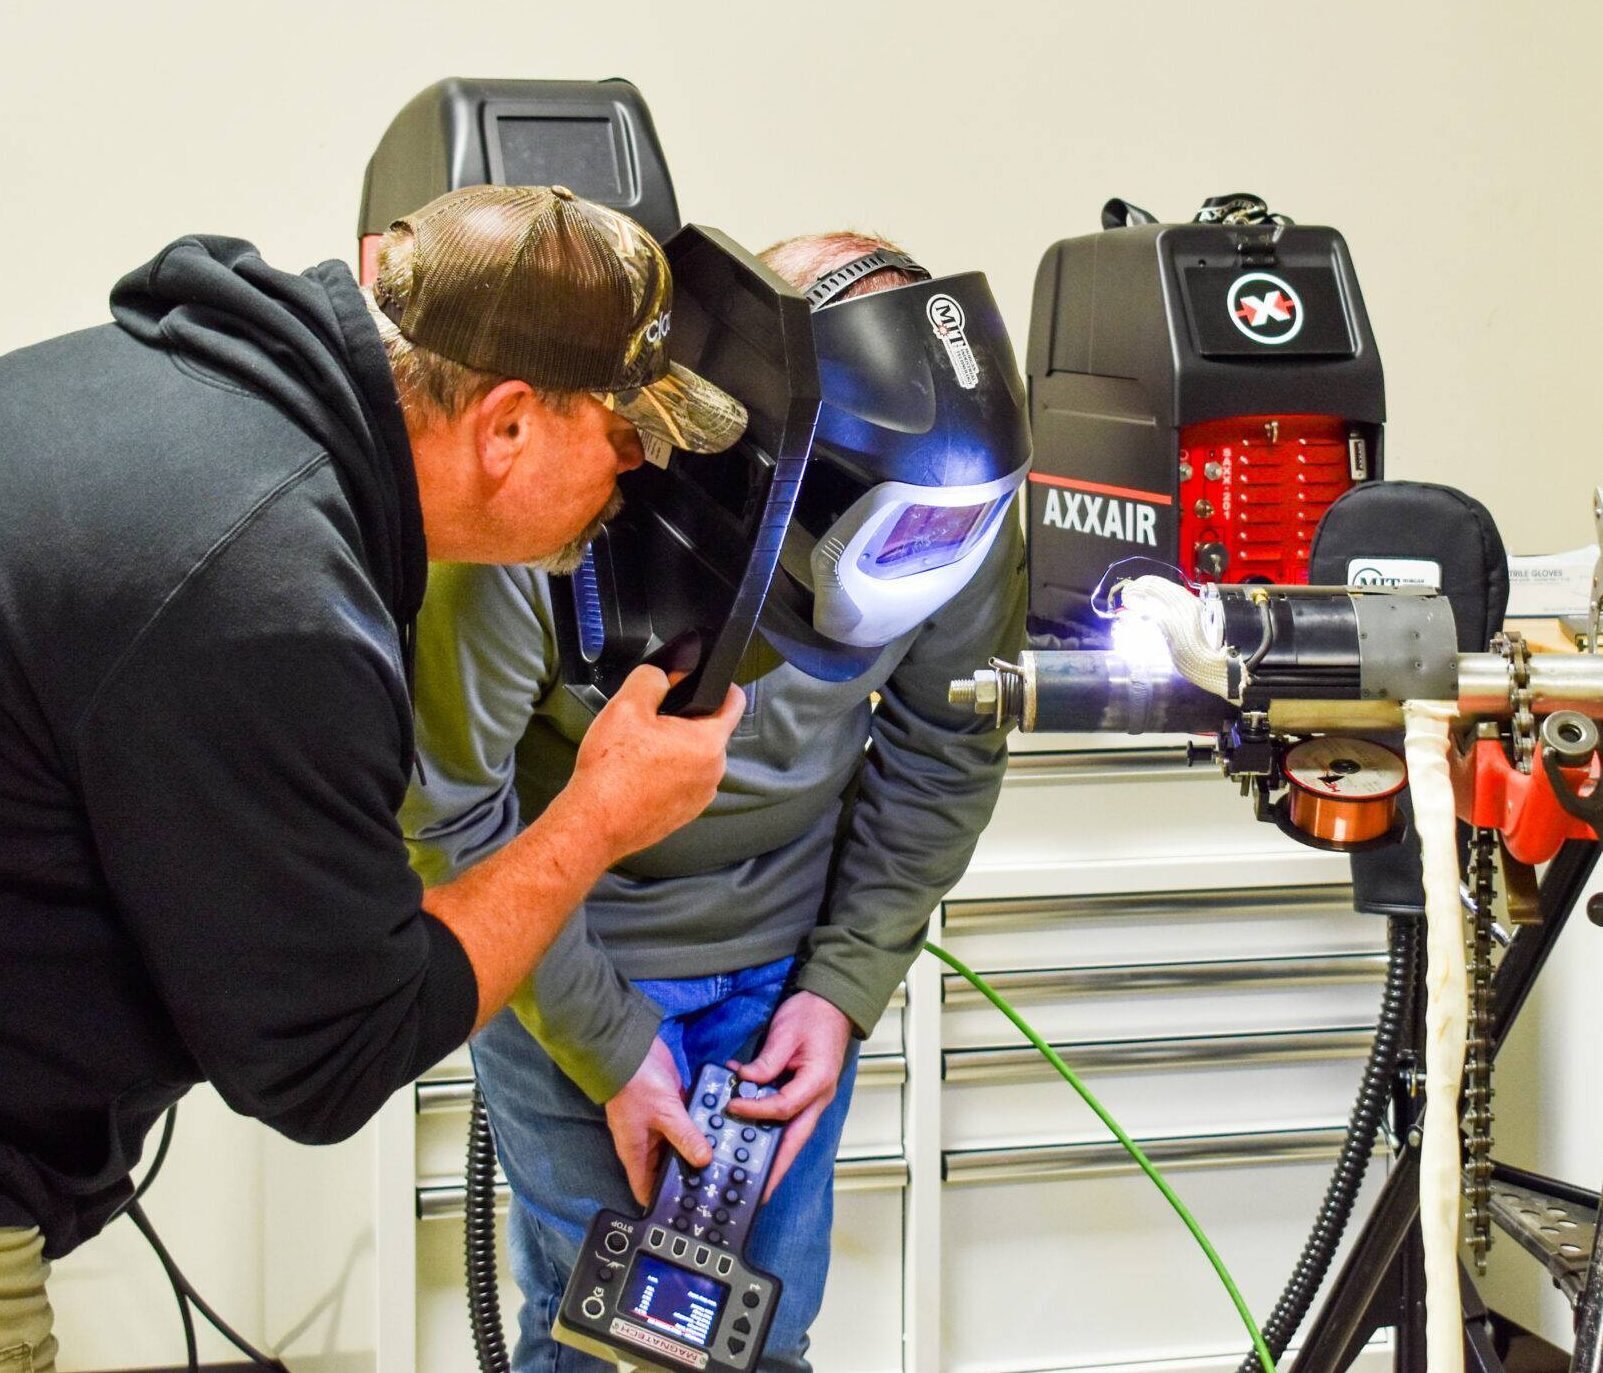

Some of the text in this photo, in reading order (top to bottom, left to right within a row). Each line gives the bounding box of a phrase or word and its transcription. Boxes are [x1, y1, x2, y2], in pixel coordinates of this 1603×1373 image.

[935, 304, 966, 347] MIT
[1043, 488, 1157, 547] AXXAIR
[1531, 568, 1563, 578] GLOVES
[611, 1220, 634, 1234] STOP
[617, 1325, 699, 1362] MAGNATECH
